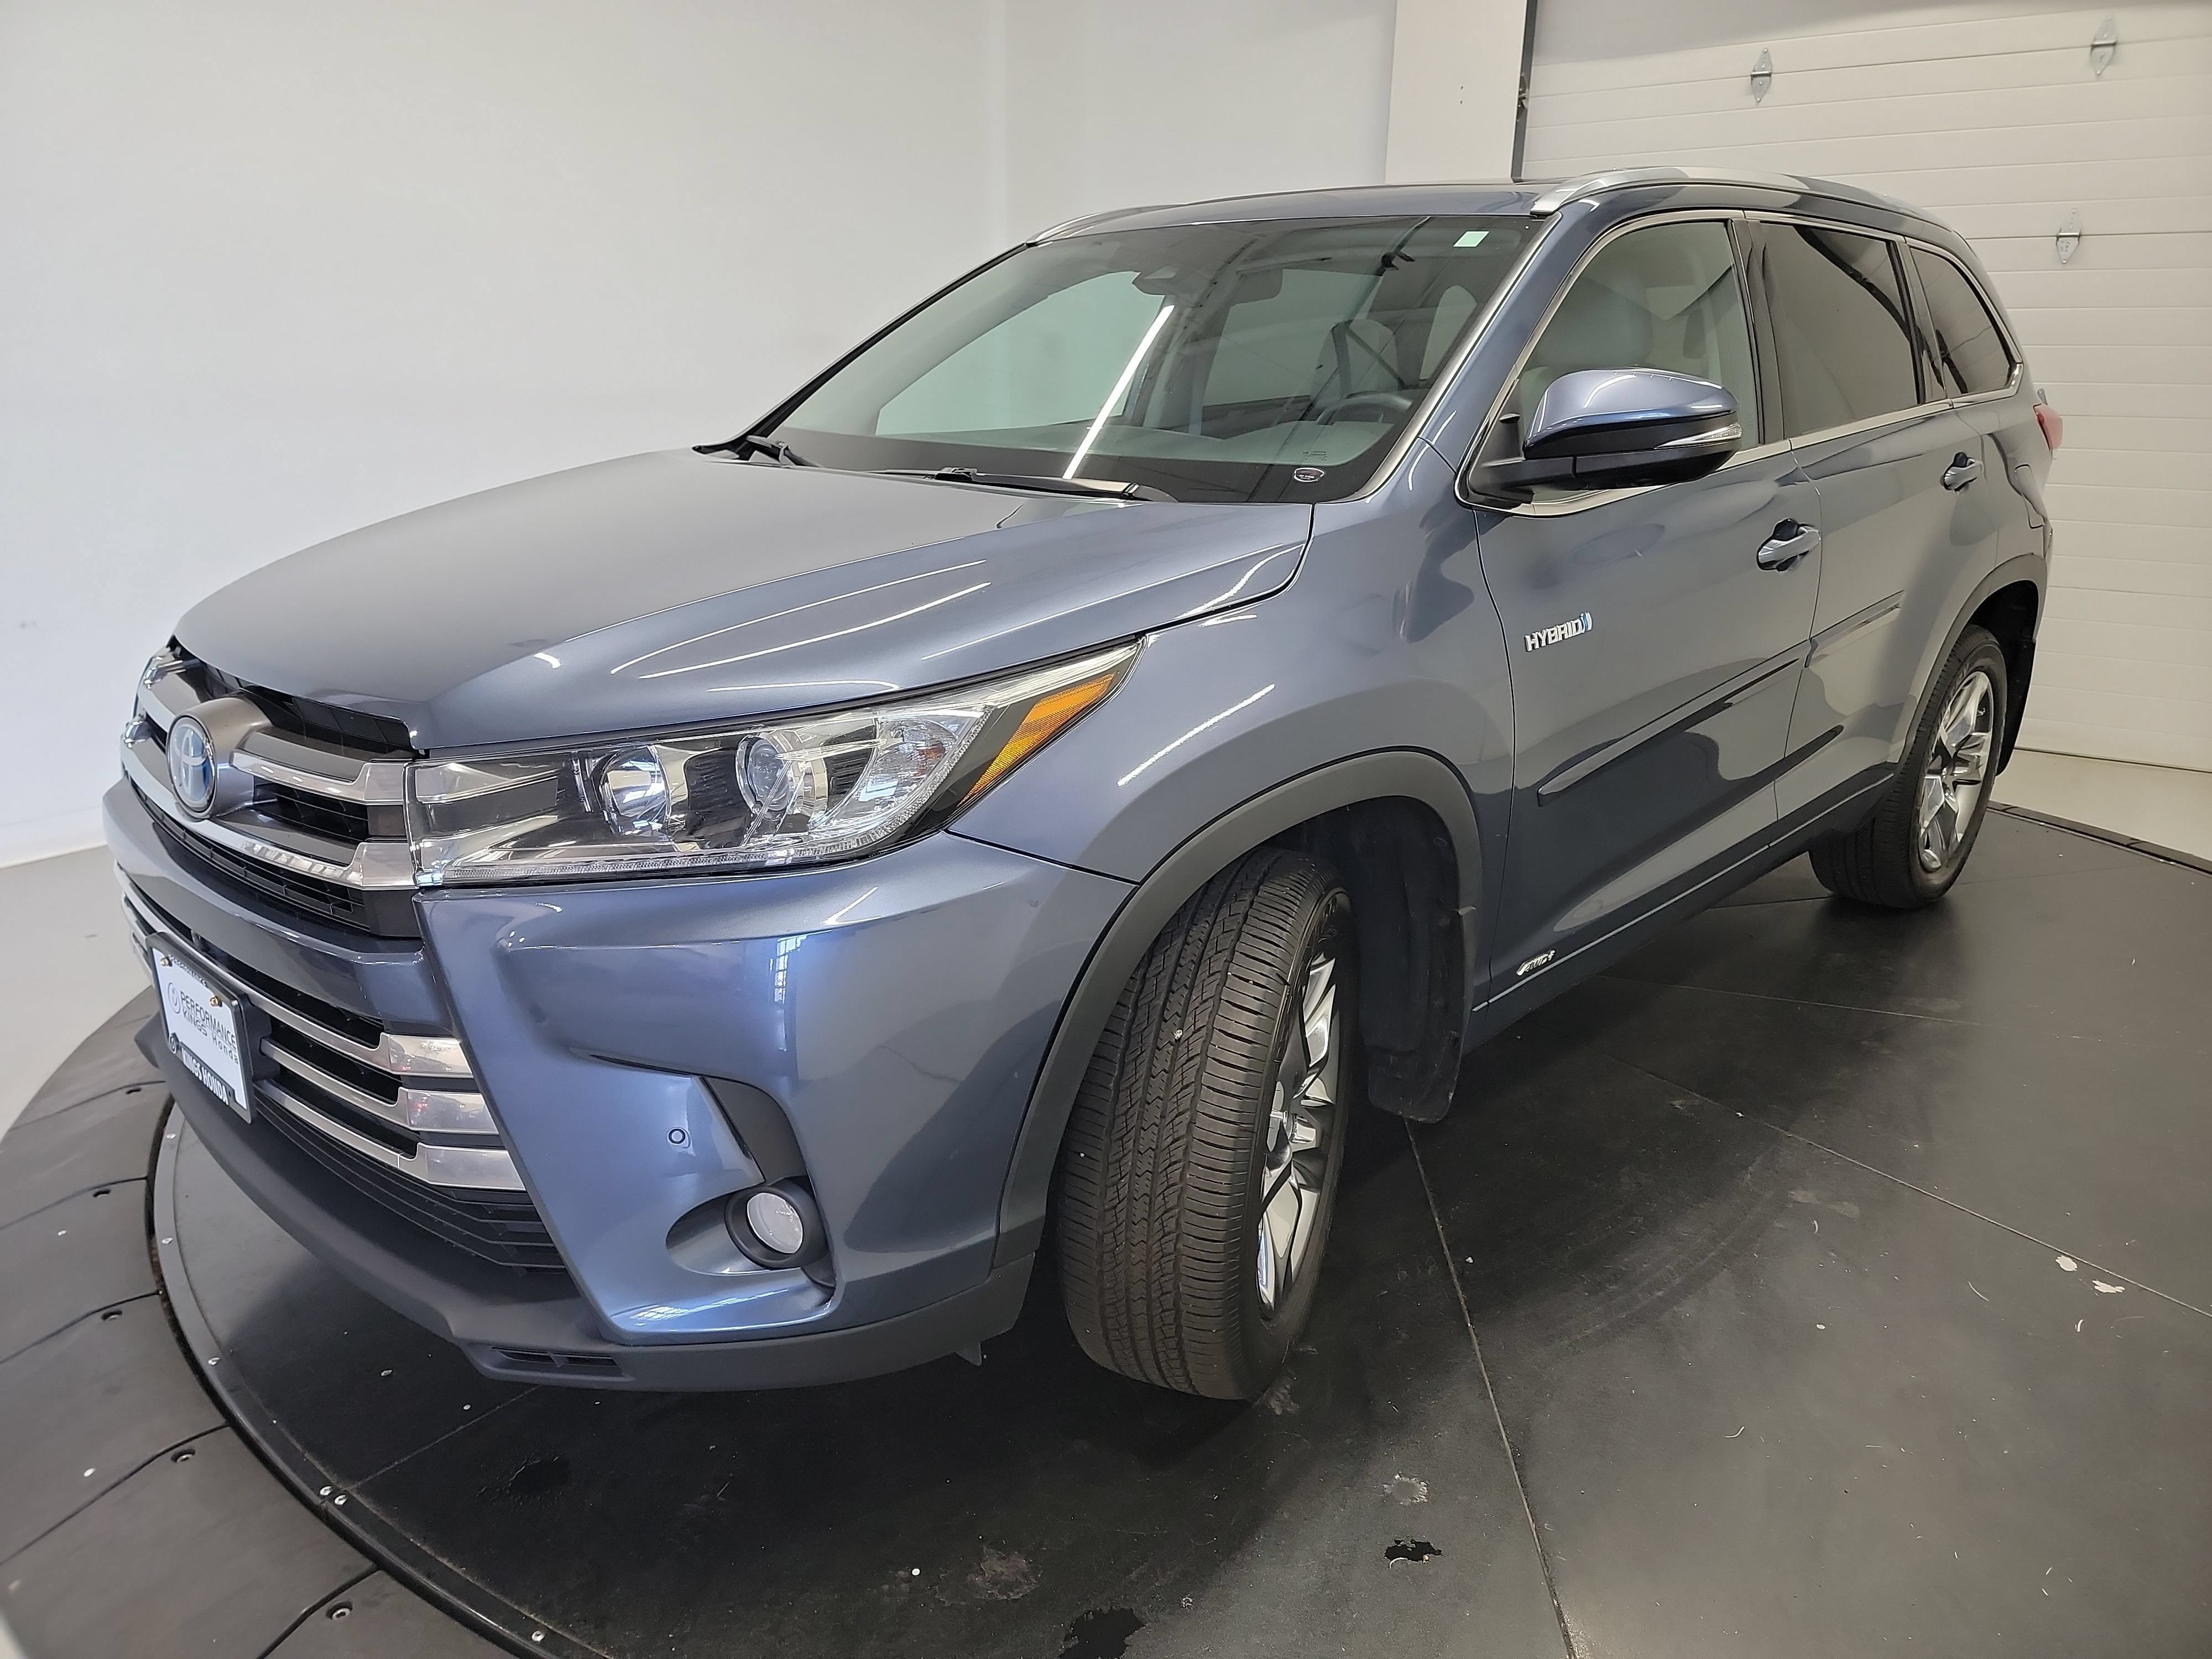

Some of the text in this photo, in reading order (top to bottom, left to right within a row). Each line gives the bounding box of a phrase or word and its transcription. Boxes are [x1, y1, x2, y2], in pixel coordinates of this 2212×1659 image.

[1524, 618, 1585, 651] HYBRID
[180, 990, 237, 1050] PERFORMANCE
[182, 1009, 239, 1065] KINGS Honda
[181, 1048, 229, 1105] KINGS HONDA
